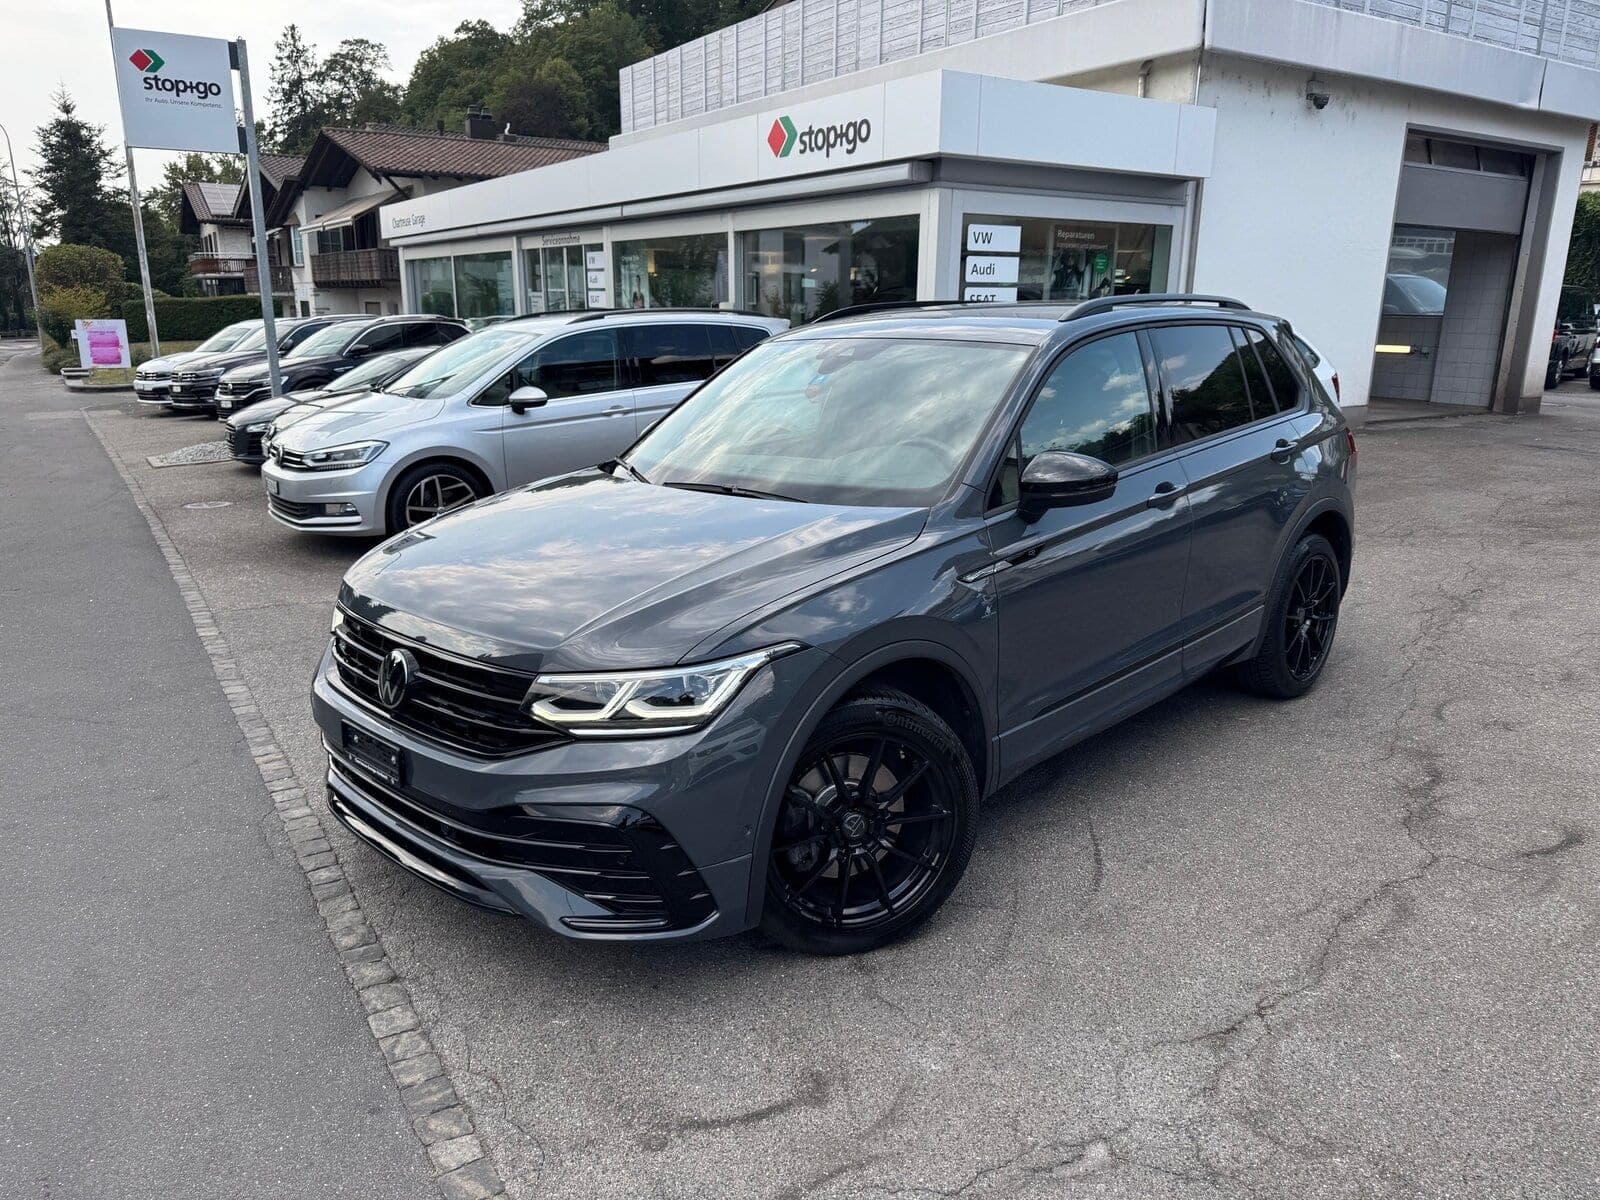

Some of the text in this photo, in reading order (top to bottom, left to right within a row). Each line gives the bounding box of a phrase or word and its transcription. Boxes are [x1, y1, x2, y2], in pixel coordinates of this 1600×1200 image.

[143, 75, 221, 99] stop+go
[799, 118, 871, 158] stop+go
[973, 231, 992, 244] VW
[1057, 229, 1095, 240] Reparaturen
[970, 262, 996, 276] Audi
[884, 710, 950, 755] Continental
